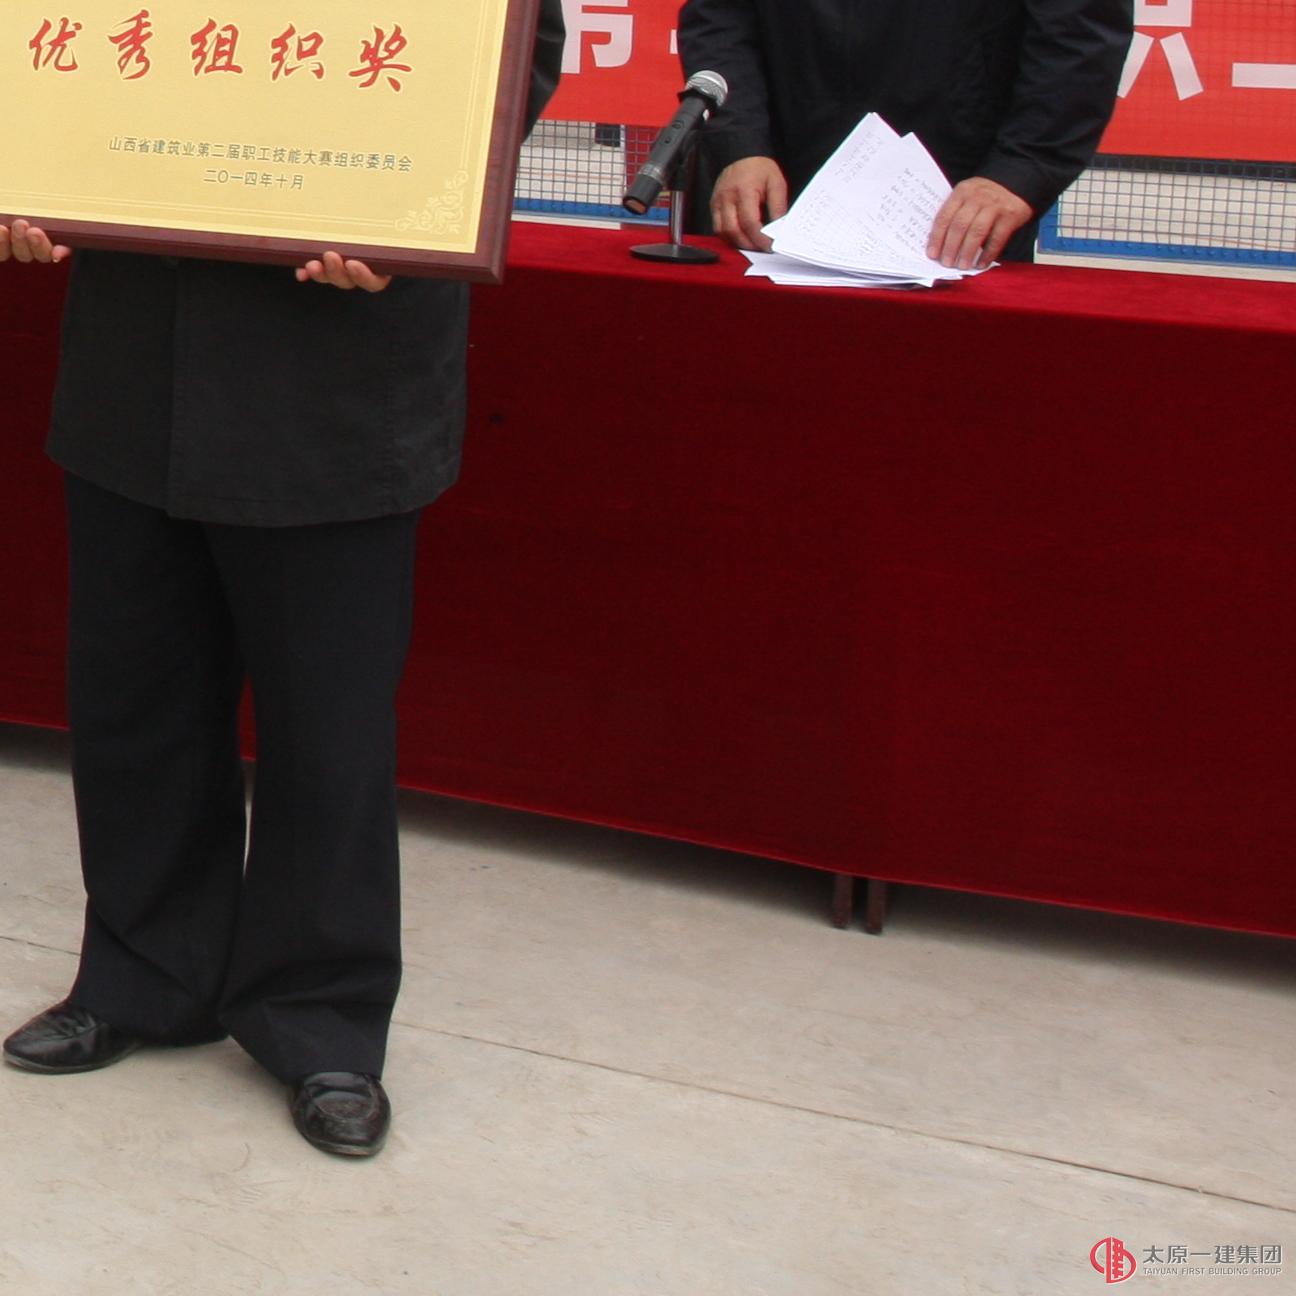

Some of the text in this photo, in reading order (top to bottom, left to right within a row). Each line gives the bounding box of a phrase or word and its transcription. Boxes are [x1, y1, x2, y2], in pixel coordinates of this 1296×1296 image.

[28, 9, 412, 92] 优秀组织奖
